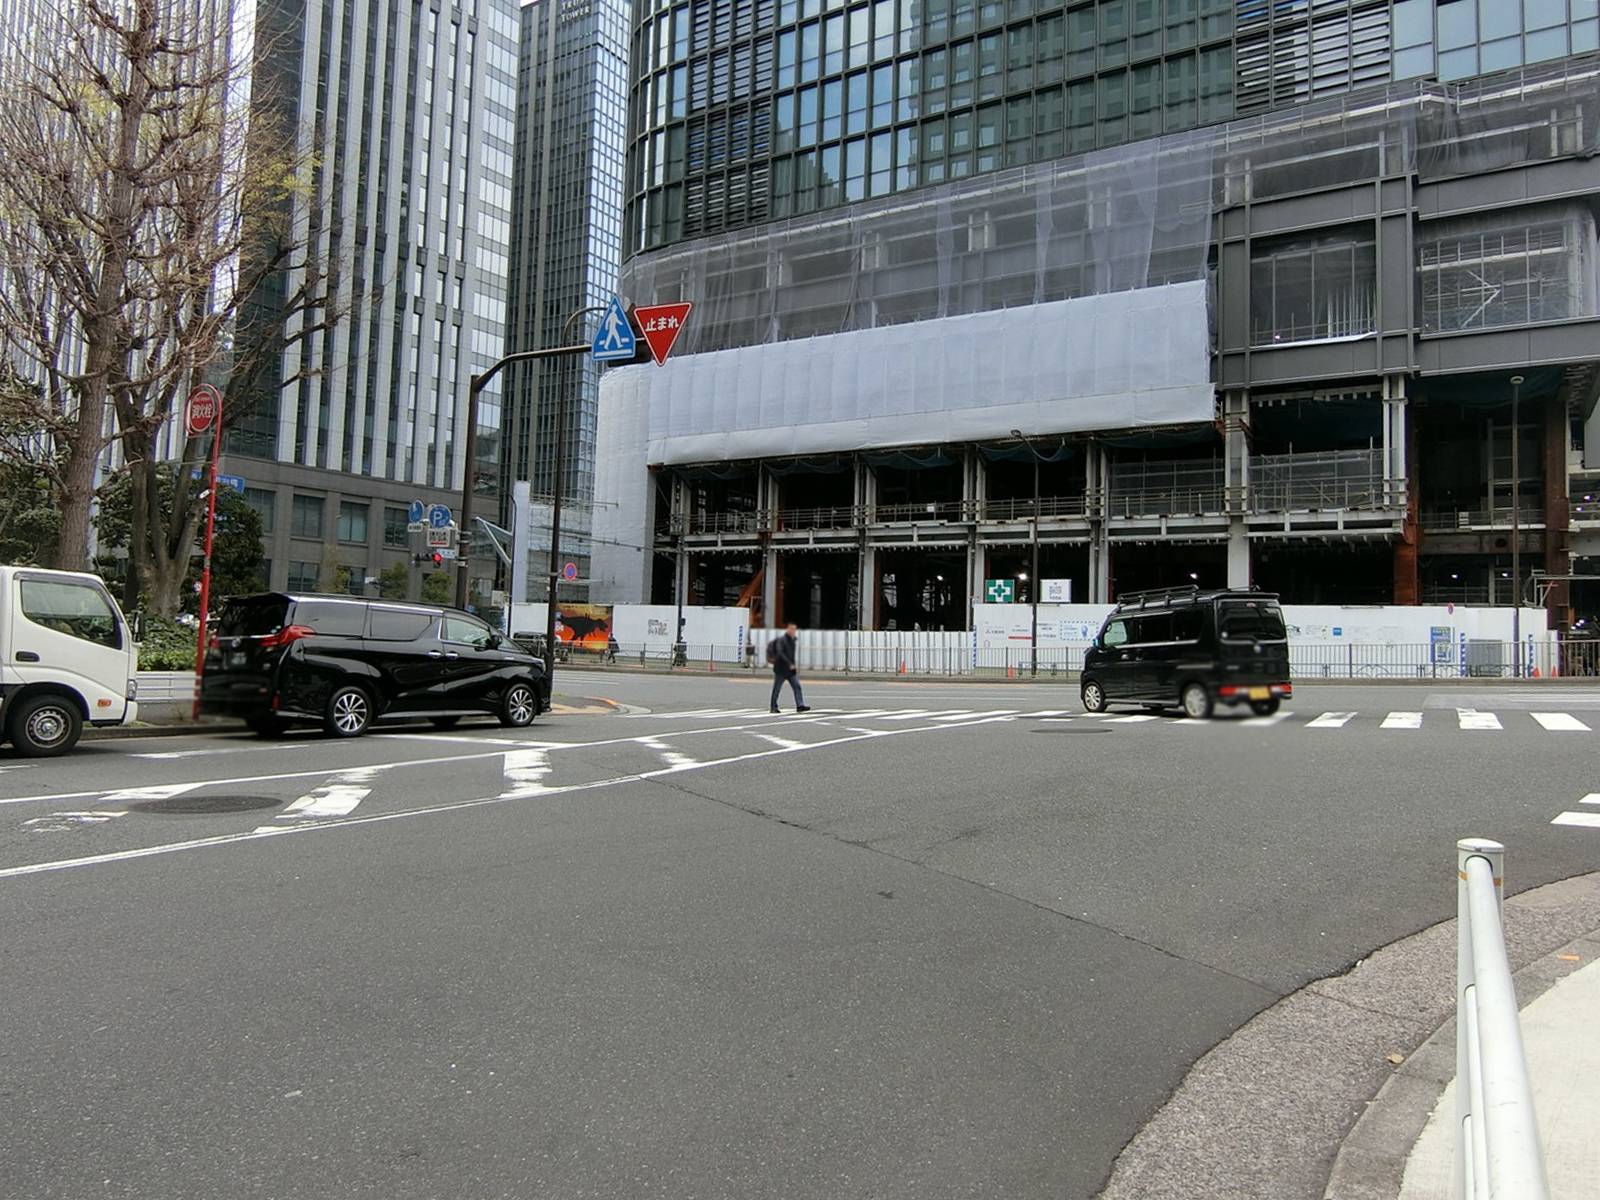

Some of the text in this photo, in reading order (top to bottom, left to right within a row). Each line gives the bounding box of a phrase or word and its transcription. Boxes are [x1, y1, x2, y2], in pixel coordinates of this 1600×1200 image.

[561, 6, 590, 22] TOWER
[645, 315, 679, 331] 止まれ
[191, 403, 212, 418] 消火栓
